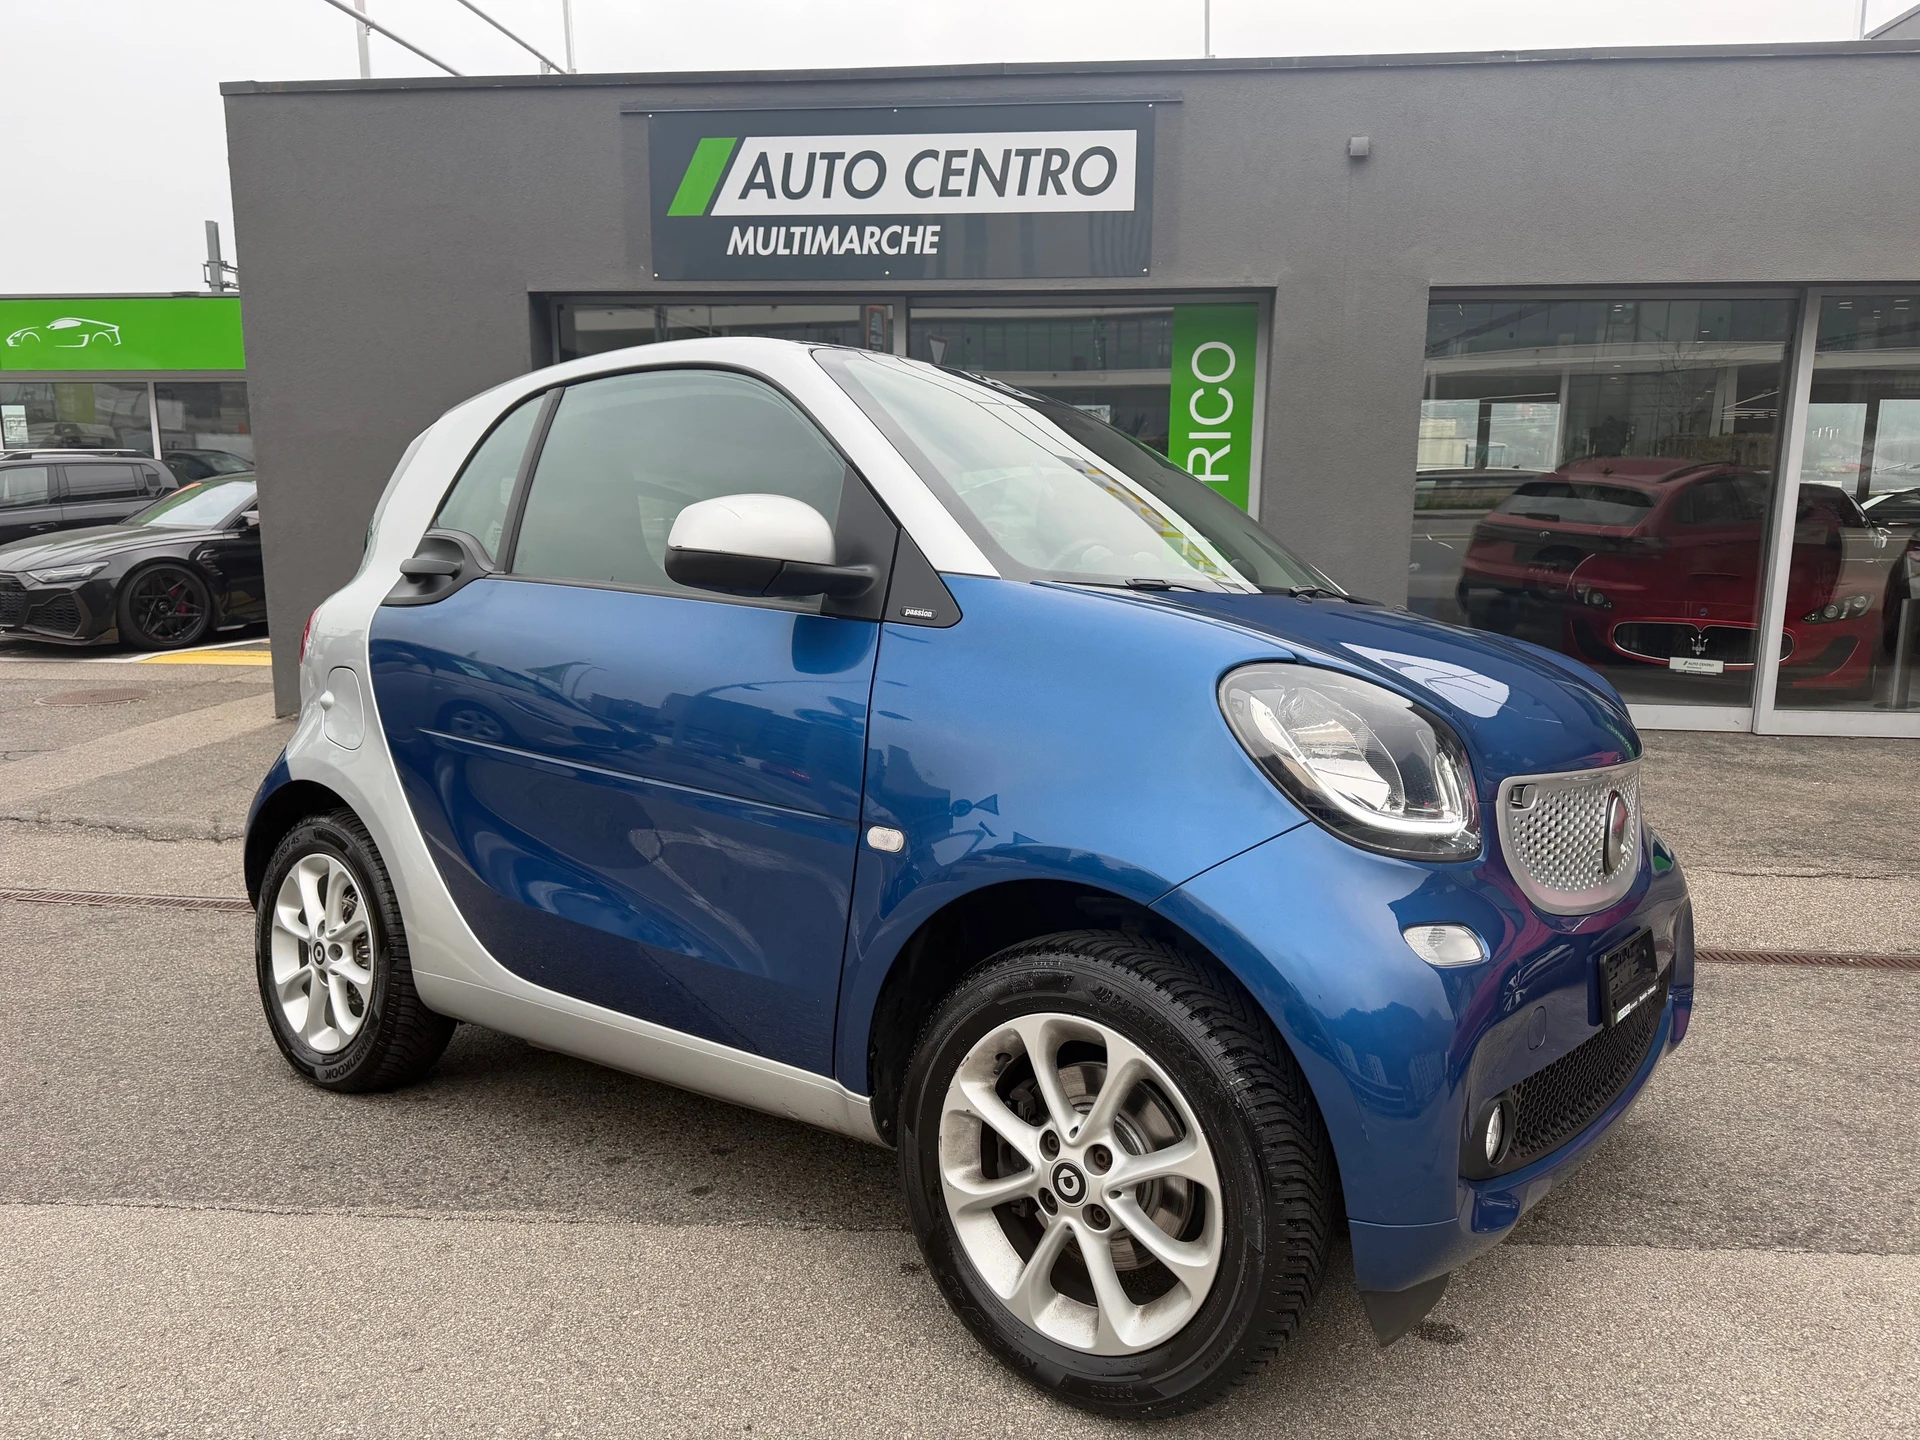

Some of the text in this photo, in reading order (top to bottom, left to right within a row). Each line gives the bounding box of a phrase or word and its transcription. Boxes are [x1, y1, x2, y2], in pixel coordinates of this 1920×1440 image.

[738, 145, 1118, 201] AUTO CENTRO
[726, 225, 942, 256] MULTIMARCHE
[1186, 341, 1236, 482] RICO
[904, 608, 933, 618] passion
